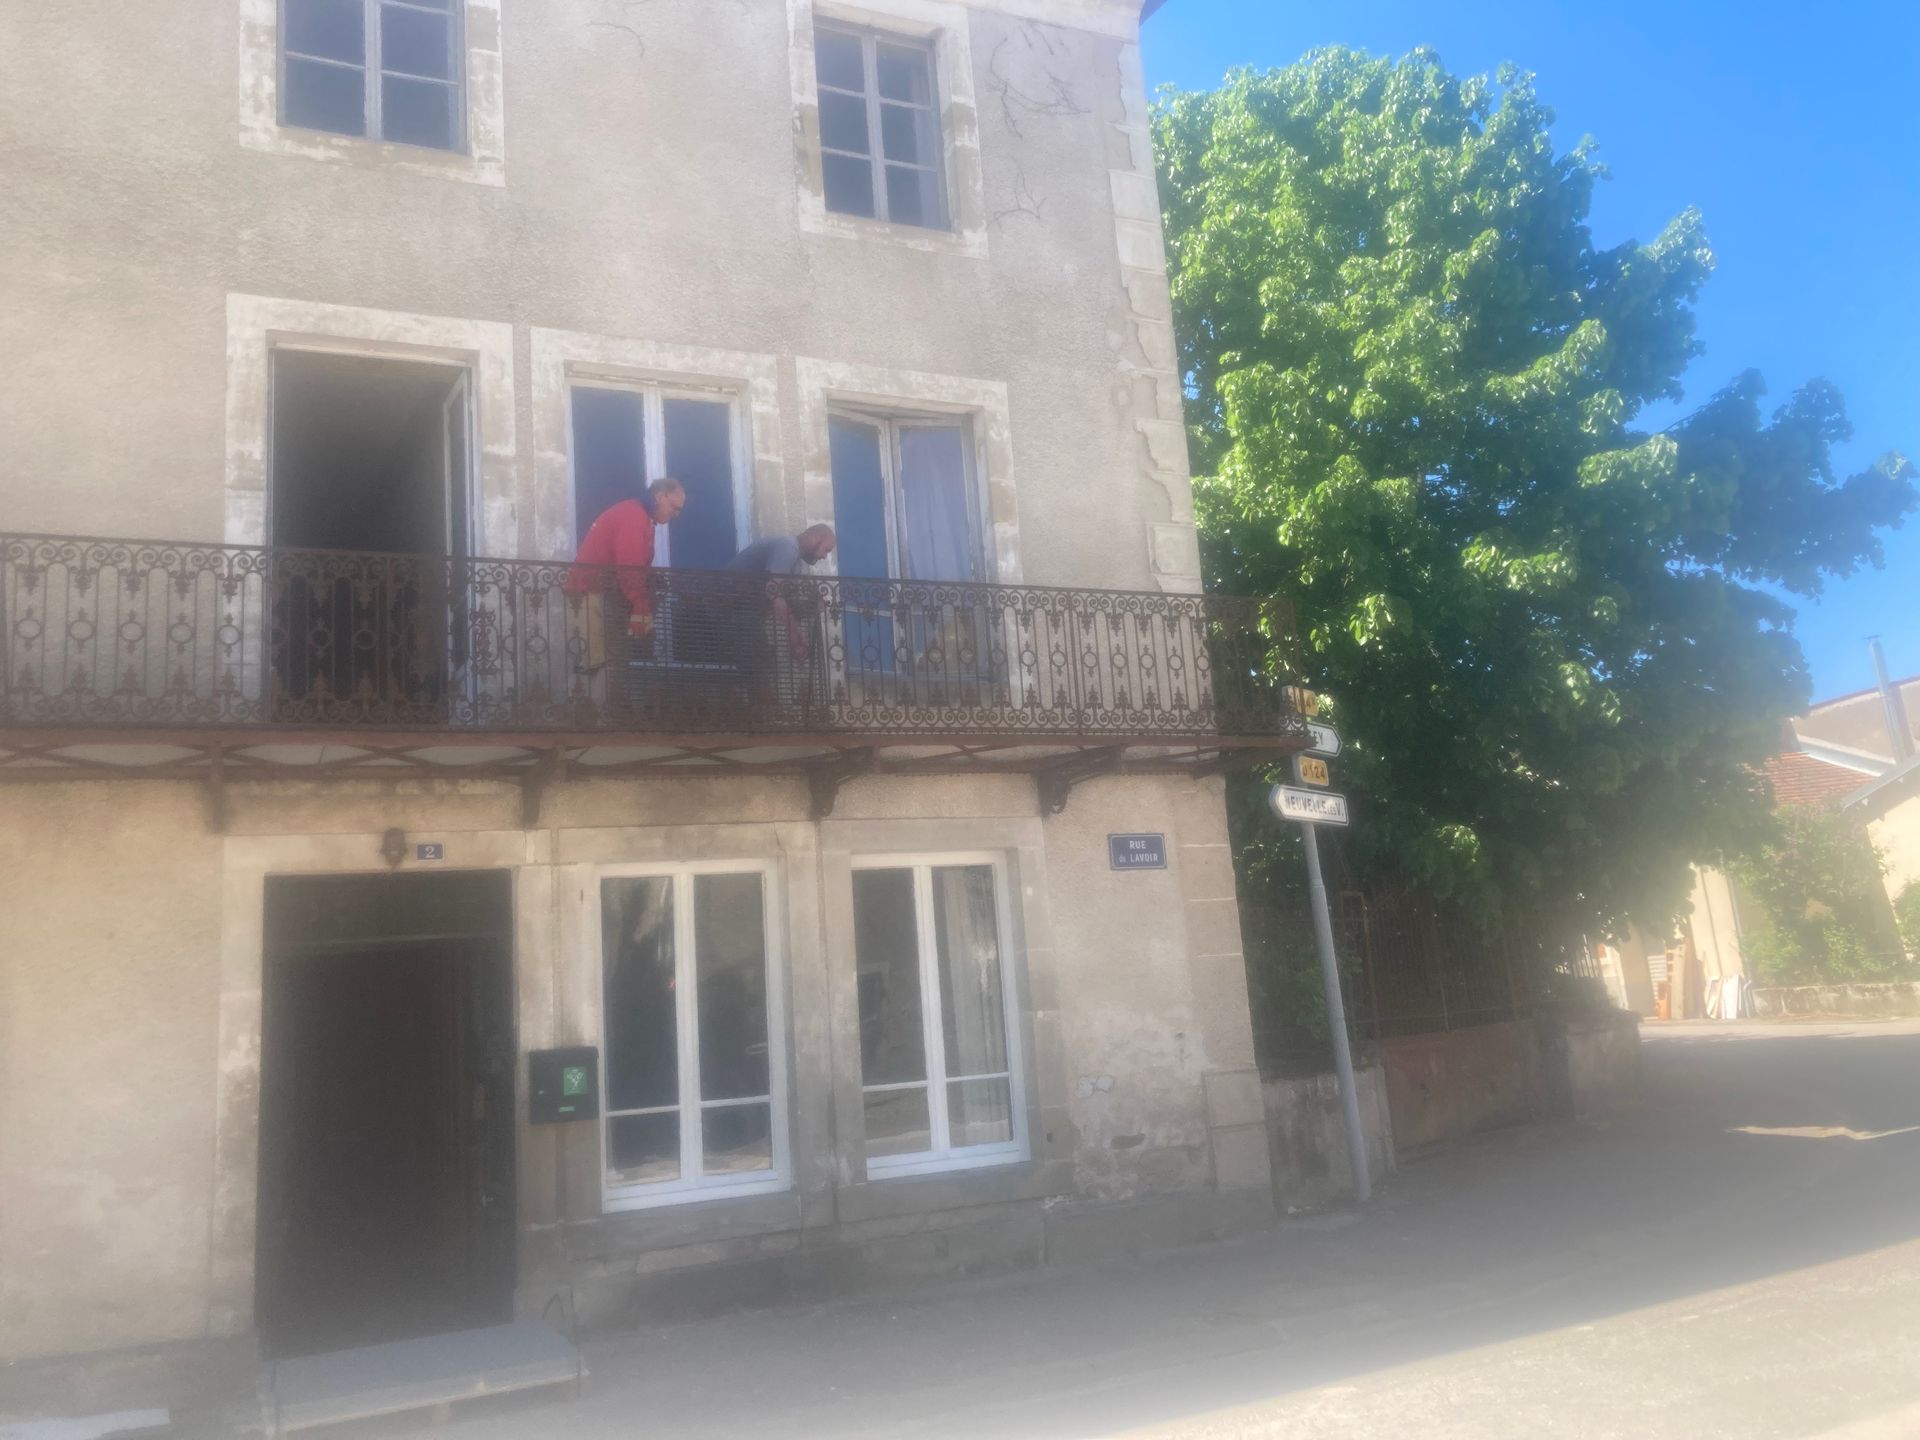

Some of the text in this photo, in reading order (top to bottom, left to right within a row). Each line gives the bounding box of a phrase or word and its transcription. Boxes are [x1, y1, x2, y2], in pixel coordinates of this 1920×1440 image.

[1285, 795, 1327, 815] NEUVELLE
[1129, 840, 1147, 849] RUE
[424, 845, 435, 858] 2
[1129, 853, 1159, 863] LAVOIR
